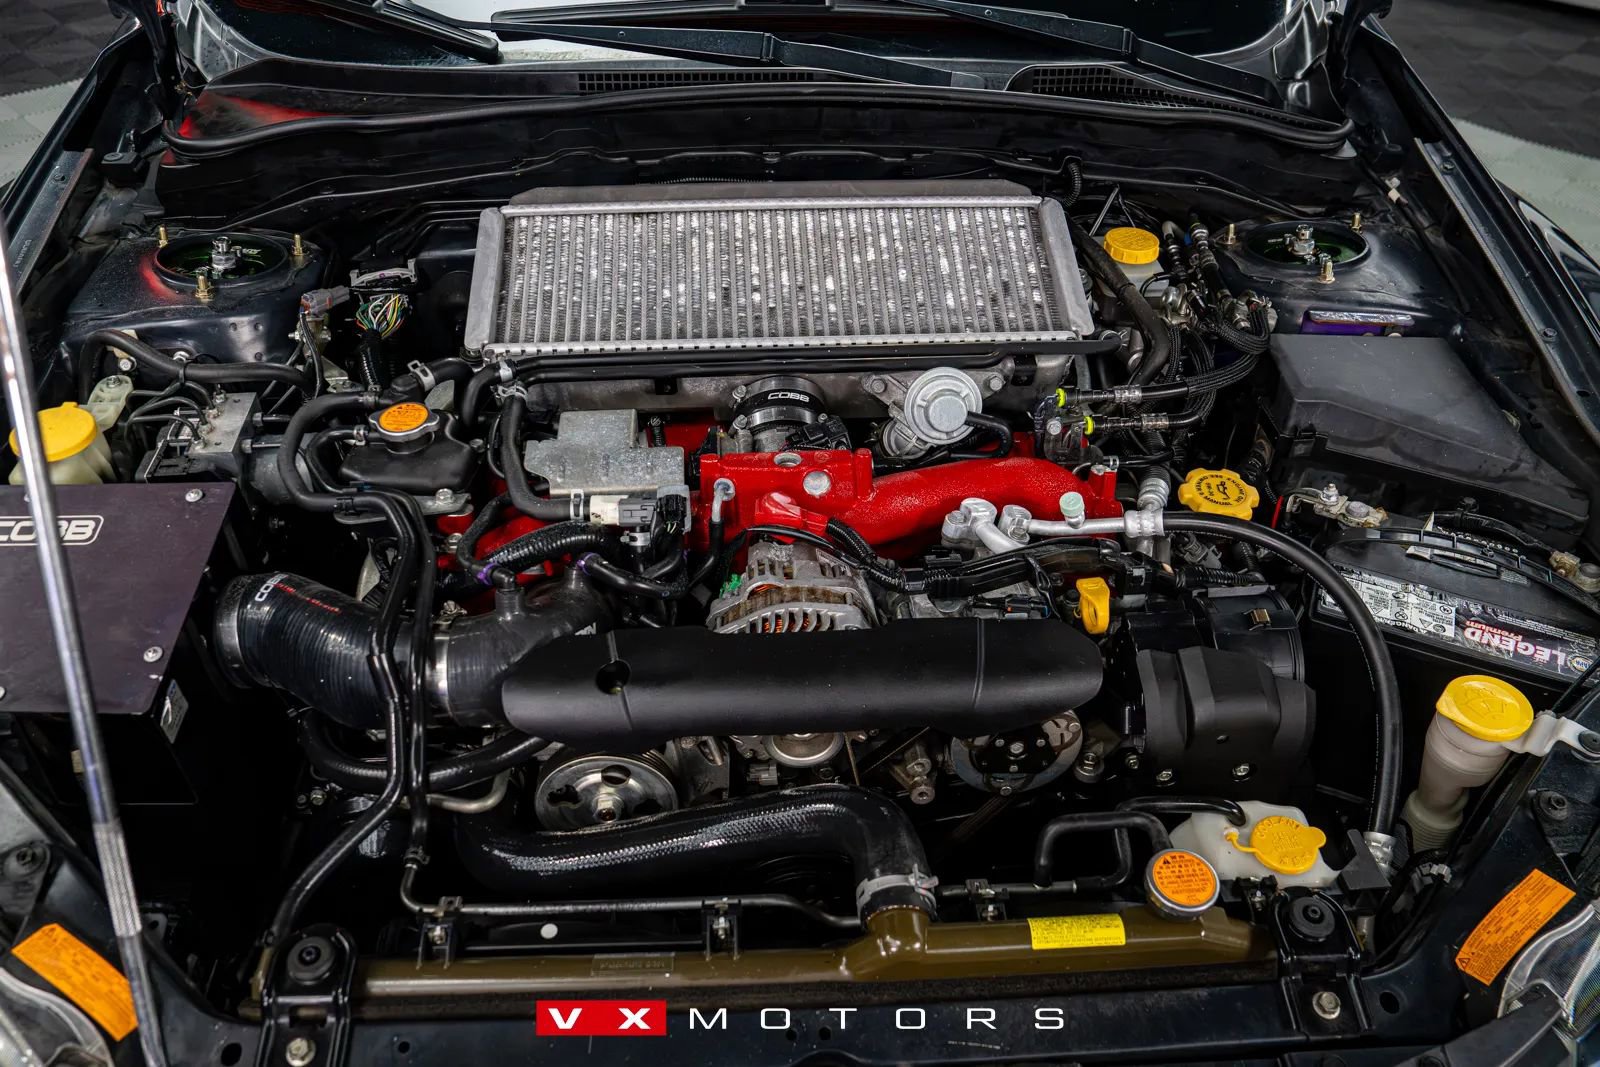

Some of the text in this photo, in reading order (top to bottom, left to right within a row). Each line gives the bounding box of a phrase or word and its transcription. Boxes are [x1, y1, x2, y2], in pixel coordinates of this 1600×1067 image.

[768, 392, 809, 402] COBB
[1465, 620, 1523, 641] Premium
[1464, 627, 1566, 666] LEGEND
